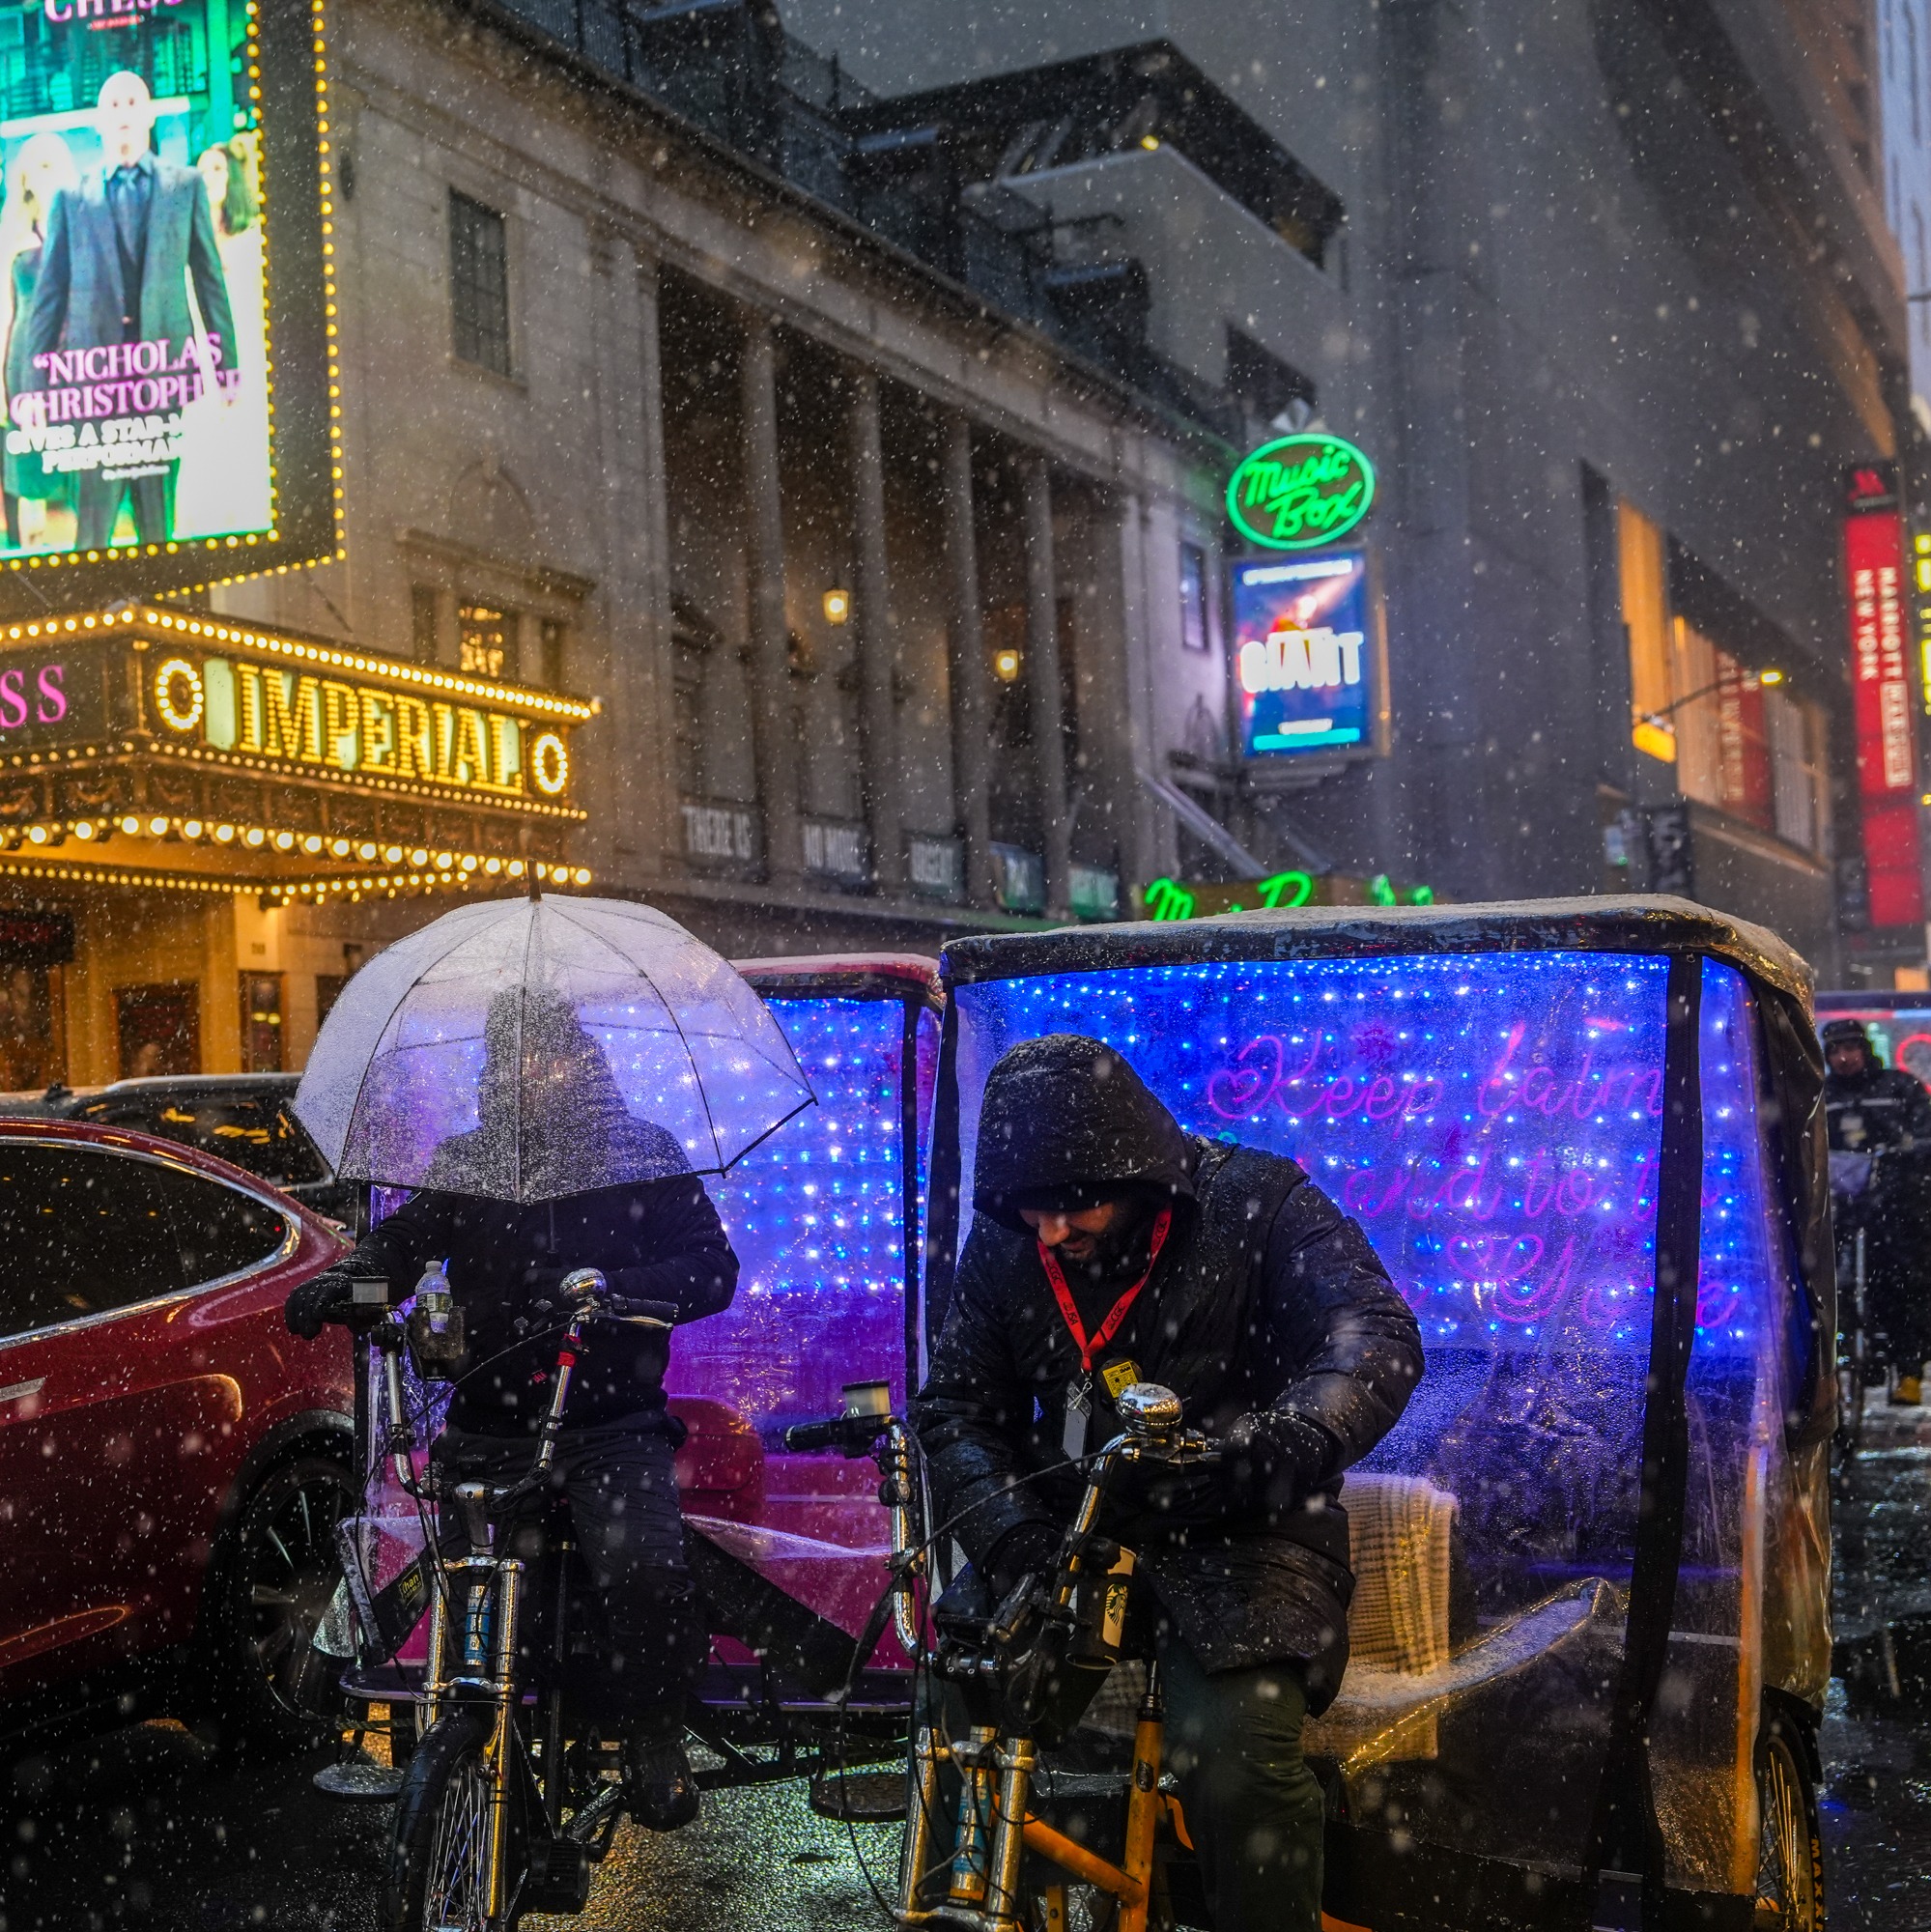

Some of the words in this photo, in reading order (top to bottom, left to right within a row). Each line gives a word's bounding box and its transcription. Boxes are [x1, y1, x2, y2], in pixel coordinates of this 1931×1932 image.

[1243, 444, 1351, 508] Music
[1264, 480, 1364, 538] Box
[1854, 568, 1876, 617] NEW
[1857, 621, 1880, 681] YORK
[0, 665, 67, 728] SS
[238, 663, 523, 796] IMPERIAL
[1207, 1030, 1444, 1141] Keep
[1343, 1145, 1503, 1221] and
